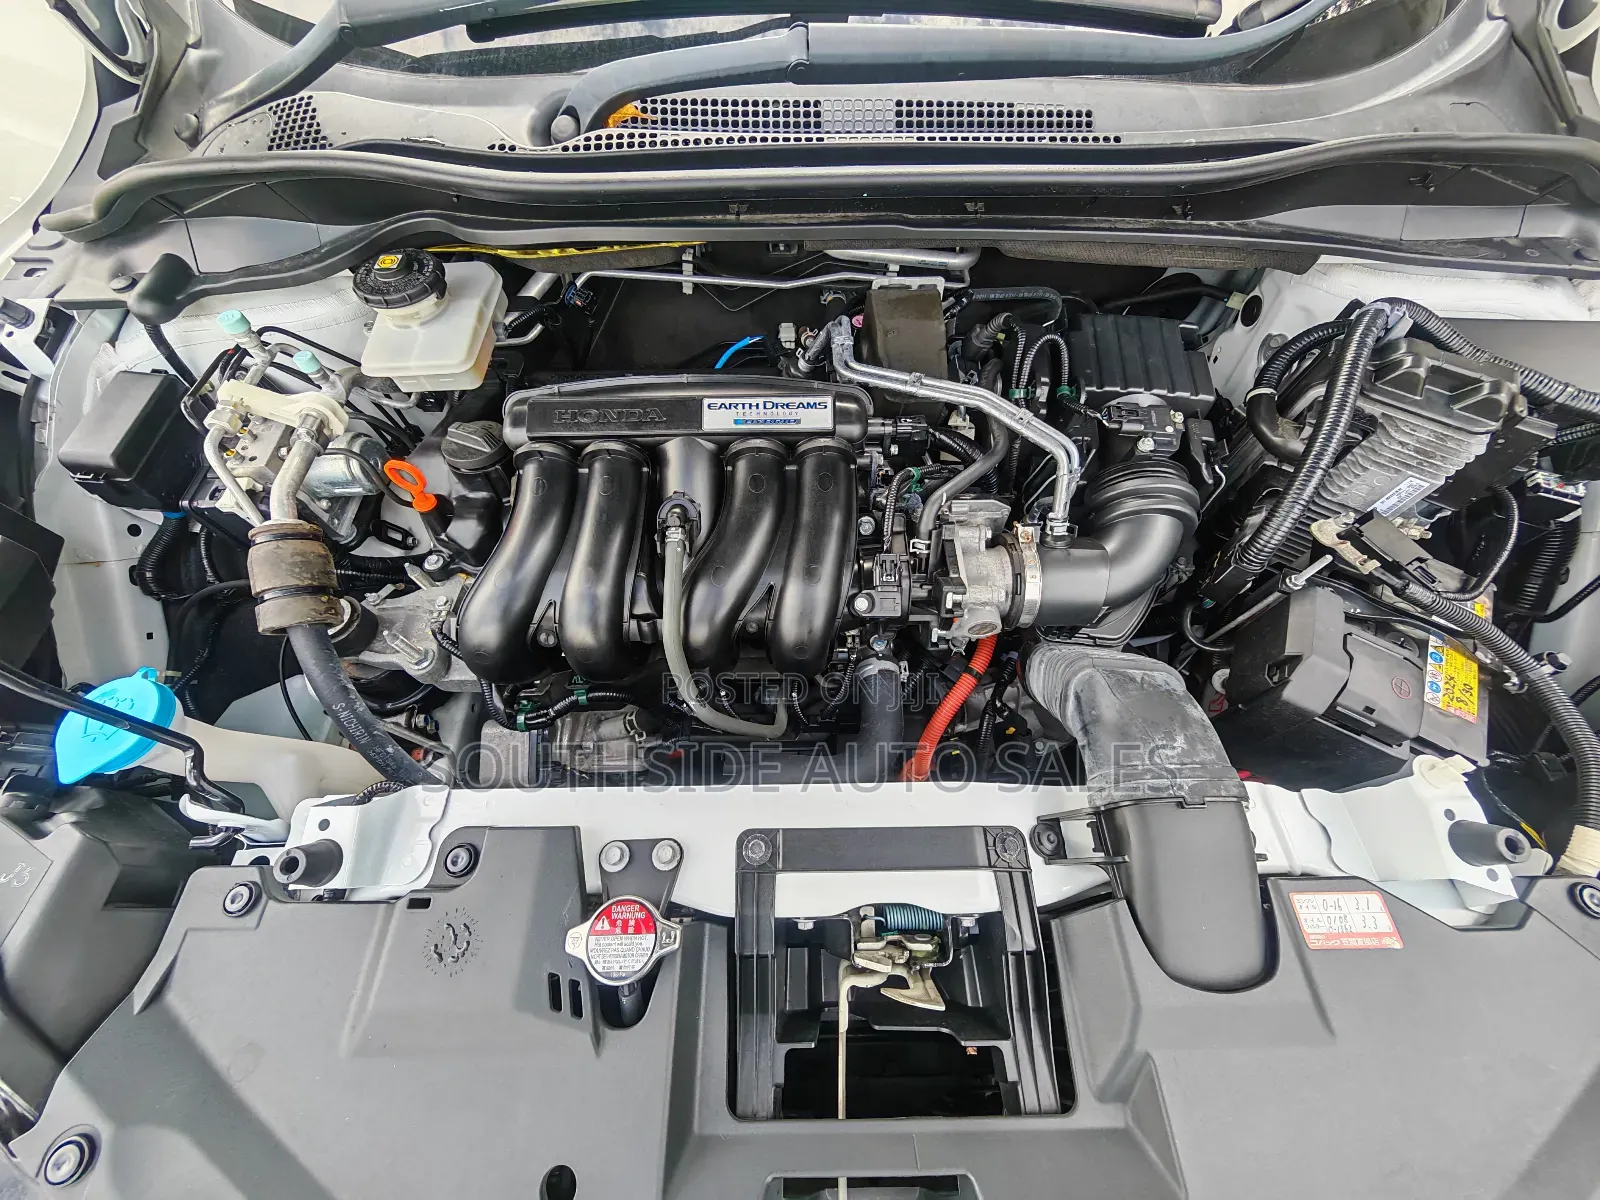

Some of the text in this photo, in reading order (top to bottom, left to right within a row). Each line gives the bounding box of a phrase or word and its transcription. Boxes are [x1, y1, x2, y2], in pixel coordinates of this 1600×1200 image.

[707, 400, 828, 411] EARTH DREAMS
[554, 408, 667, 423] HONDA
[611, 904, 640, 912] DANGER
[611, 911, 646, 920] WARNUNG
